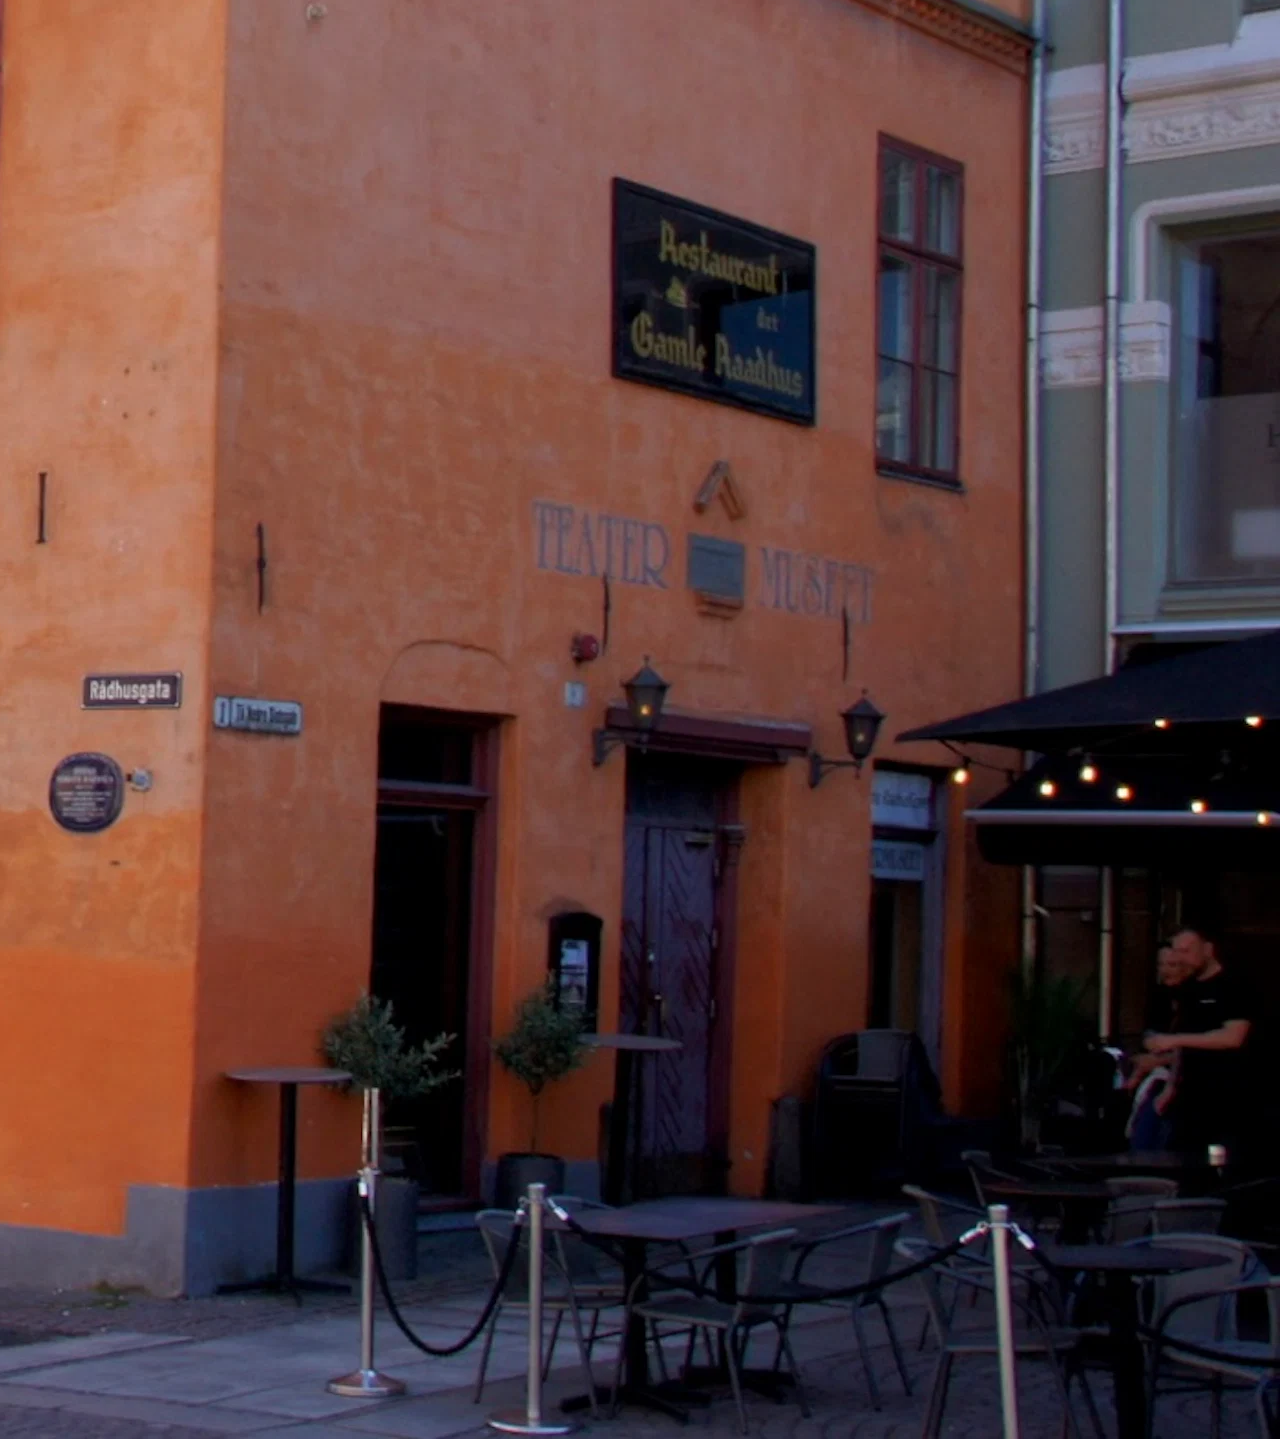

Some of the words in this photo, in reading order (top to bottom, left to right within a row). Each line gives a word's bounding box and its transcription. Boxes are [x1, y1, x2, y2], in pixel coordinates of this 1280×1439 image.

[659, 217, 779, 295] Restaurant
[630, 312, 707, 372] Gamle
[715, 332, 803, 398] Raadhus
[533, 500, 671, 590] TEATER
[760, 546, 874, 626] MUSEET
[89, 680, 171, 704] Rådhusgata
